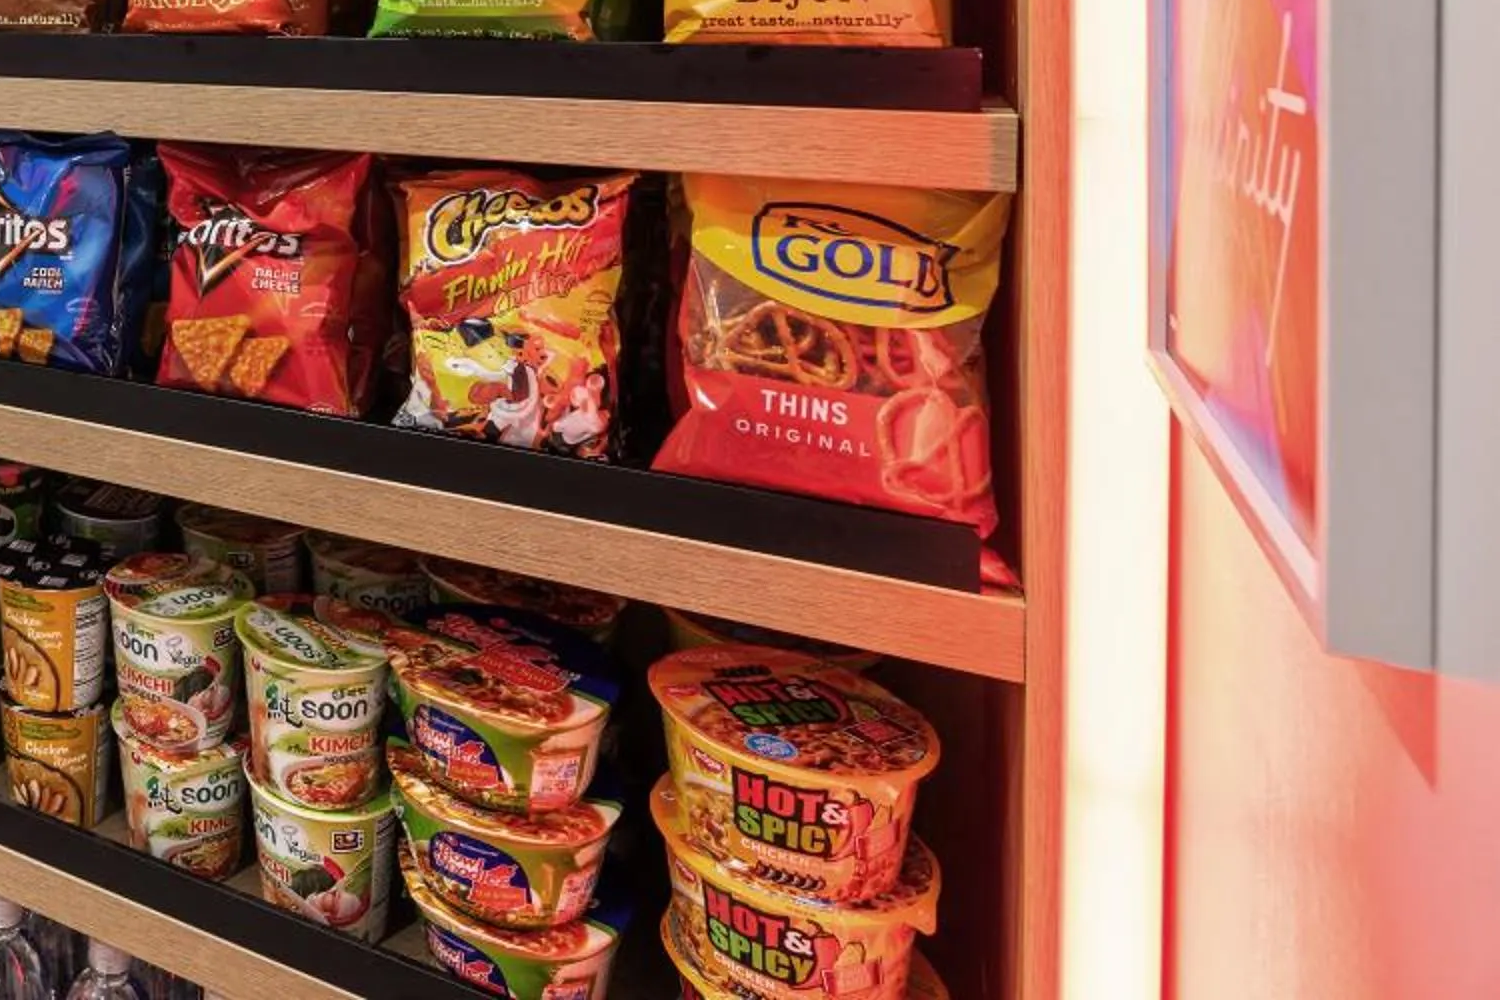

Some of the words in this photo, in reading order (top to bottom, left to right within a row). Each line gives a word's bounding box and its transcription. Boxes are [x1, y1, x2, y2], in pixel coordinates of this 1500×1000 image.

[255, 267, 300, 281] NACHO
[775, 233, 941, 298] GOLD
[251, 279, 300, 294] CHEESE
[761, 388, 849, 426] THINS
[735, 418, 872, 458] ORIGINAL
[301, 698, 369, 721] soon
[182, 780, 240, 804] soon
[737, 771, 826, 825] HOT
[820, 801, 850, 827] &
[736, 804, 849, 855] SPICY
[706, 884, 786, 949] HOT
[783, 930, 815, 958] &
[708, 917, 815, 985] SPICY
